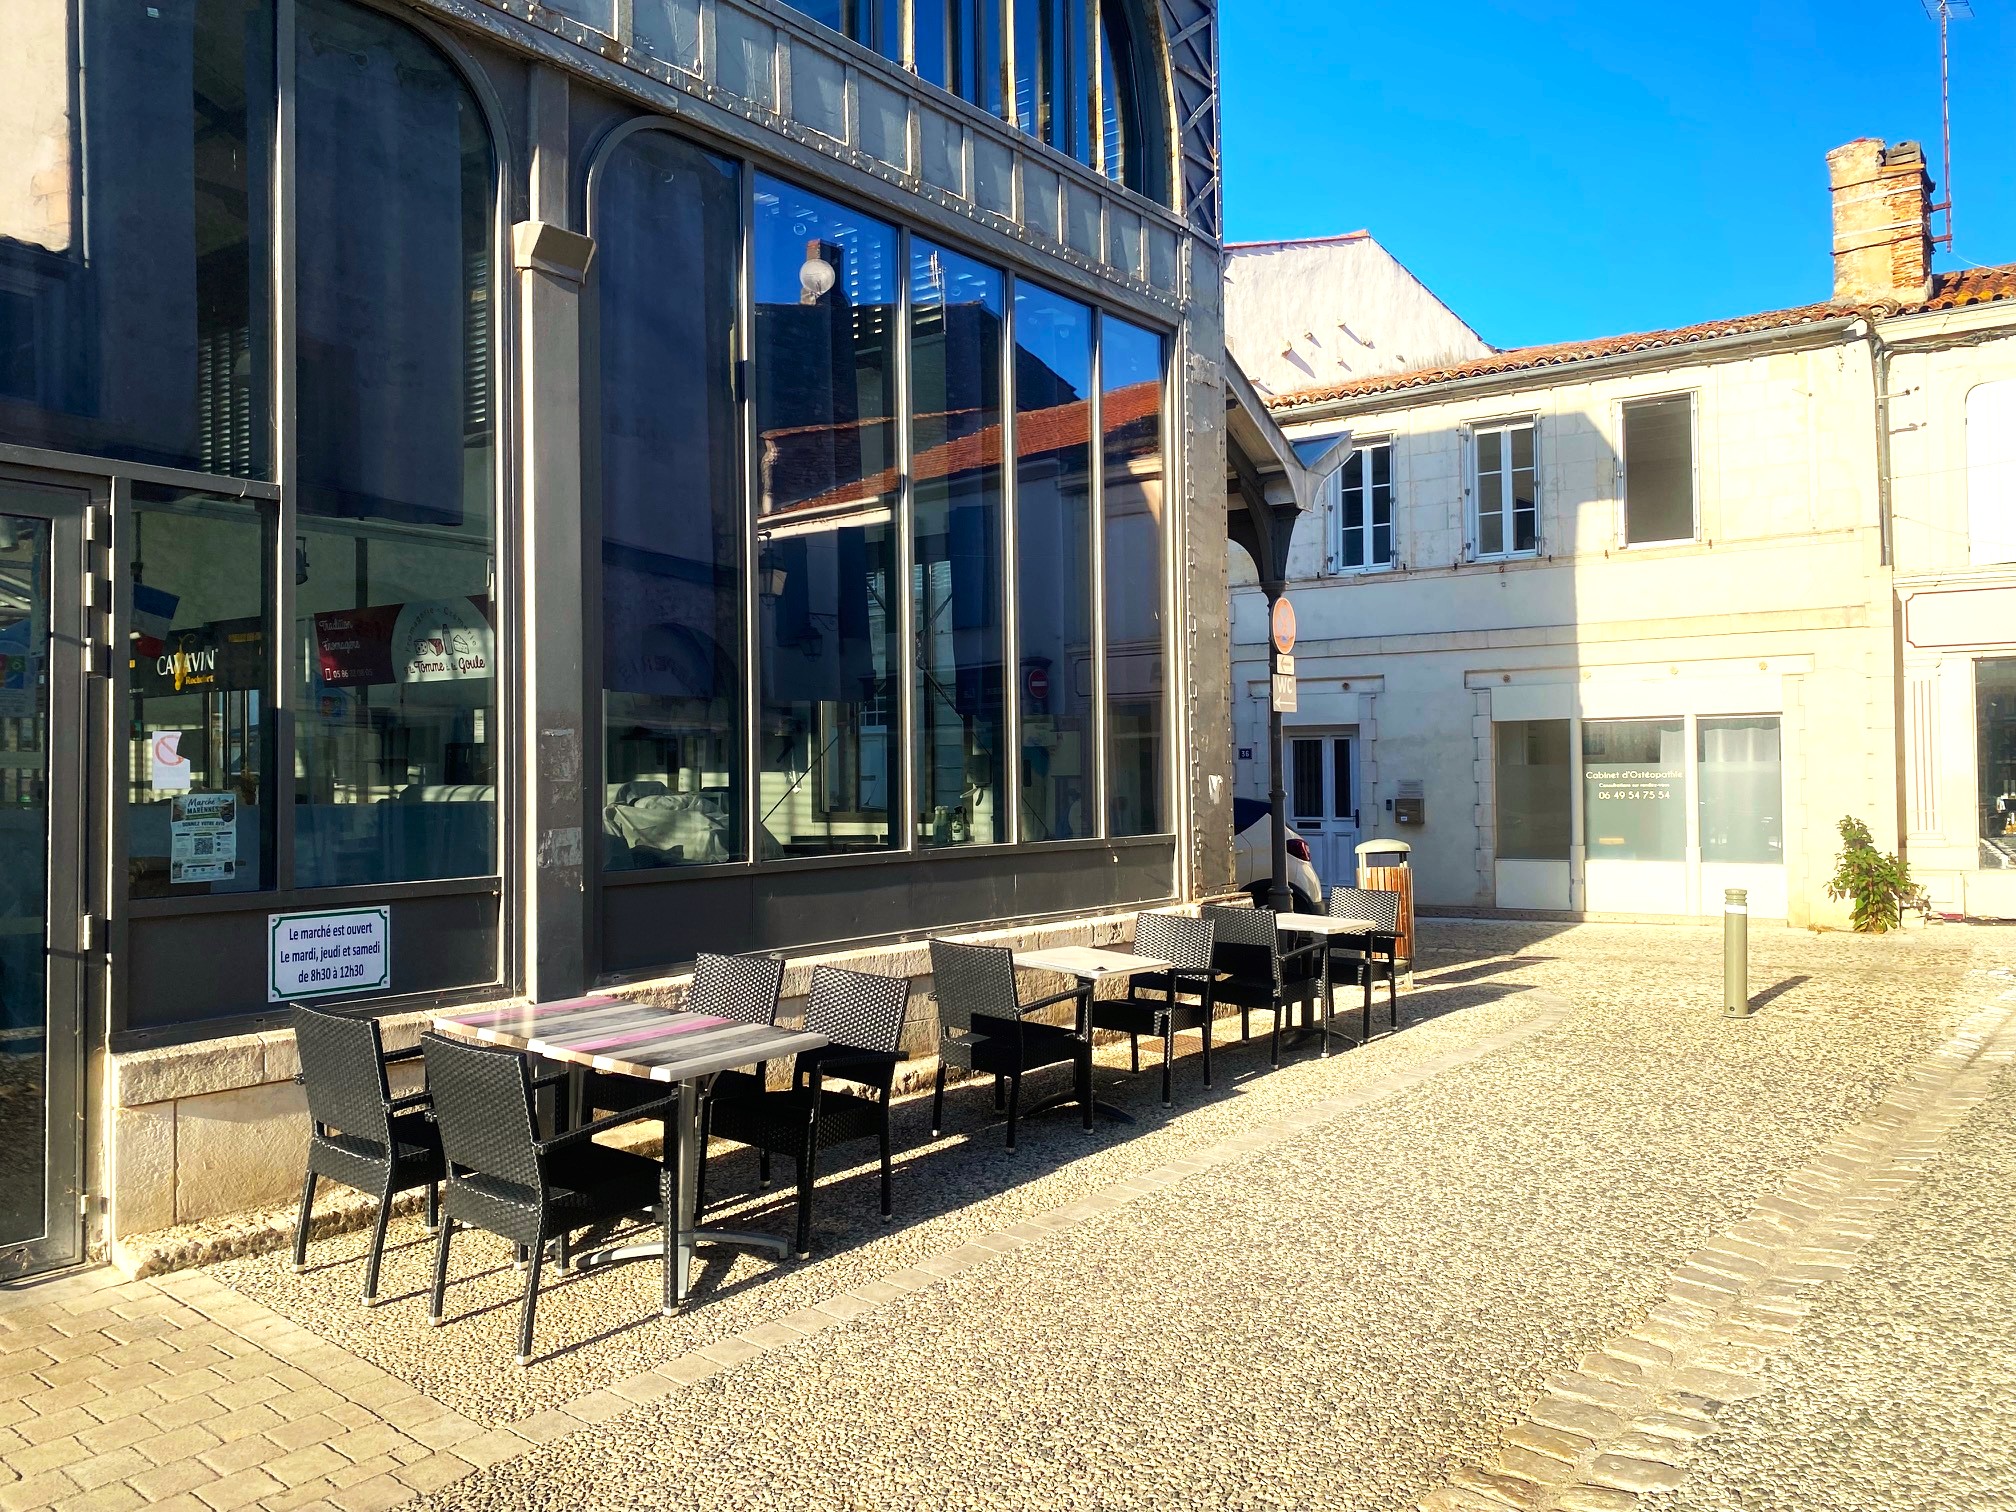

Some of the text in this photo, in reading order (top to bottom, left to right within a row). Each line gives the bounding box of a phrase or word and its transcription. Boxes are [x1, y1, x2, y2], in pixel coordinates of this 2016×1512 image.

[319, 618, 353, 631] Tradition
[414, 660, 445, 674] Tomme
[458, 655, 486, 674] Goule
[332, 669, 341, 678] 05
[1276, 676, 1293, 694] WC
[1241, 750, 1250, 758] 36
[1585, 770, 1683, 780] Cabinet d'Ostéopathie
[1598, 791, 1670, 800] 06 49 54 75 54
[187, 806, 221, 814] MARENNES
[289, 922, 373, 941] Le marché est ouvert
[280, 941, 380, 963] Le mardi, jeudi et samedi
[298, 964, 364, 983] de 8h30 à 12h30
